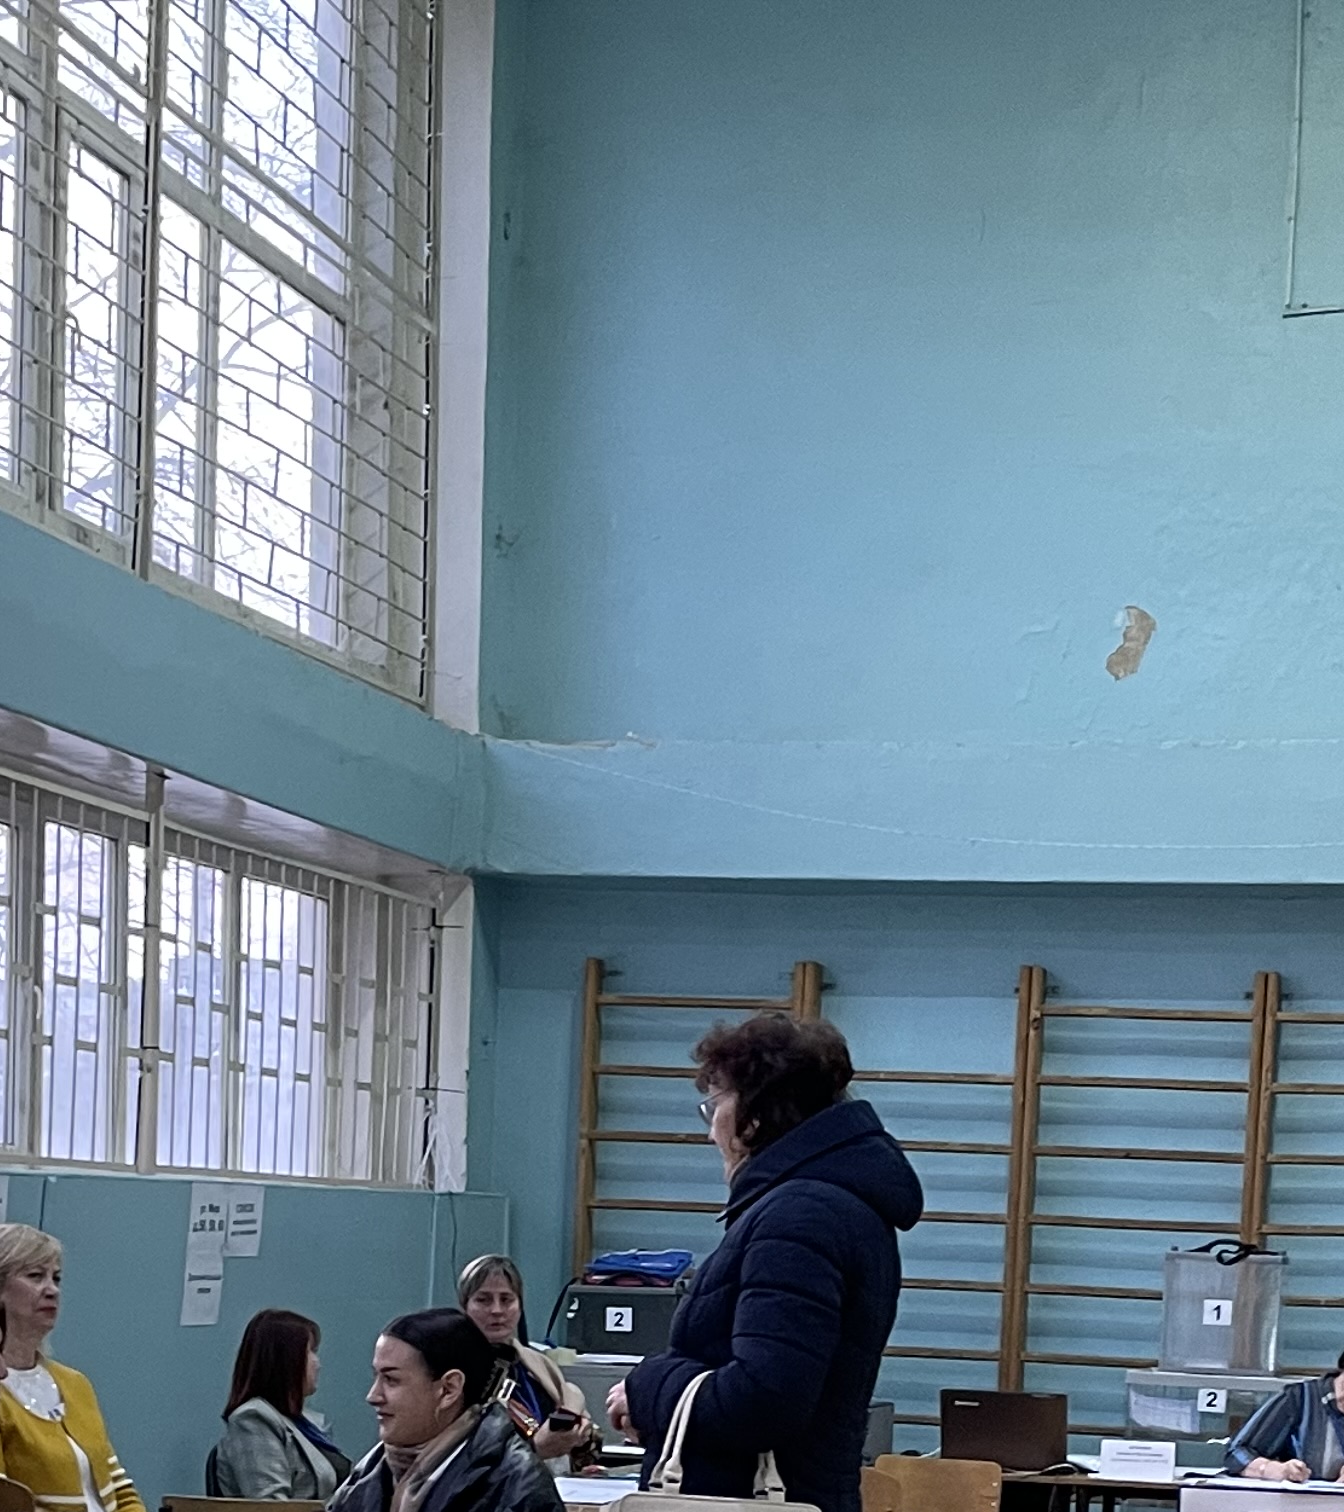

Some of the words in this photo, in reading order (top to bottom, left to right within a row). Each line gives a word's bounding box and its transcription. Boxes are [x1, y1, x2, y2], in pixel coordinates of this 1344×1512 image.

[613, 1311, 625, 1328] 2
[1212, 1304, 1222, 1321] 1
[1206, 1391, 1218, 1408] 2
